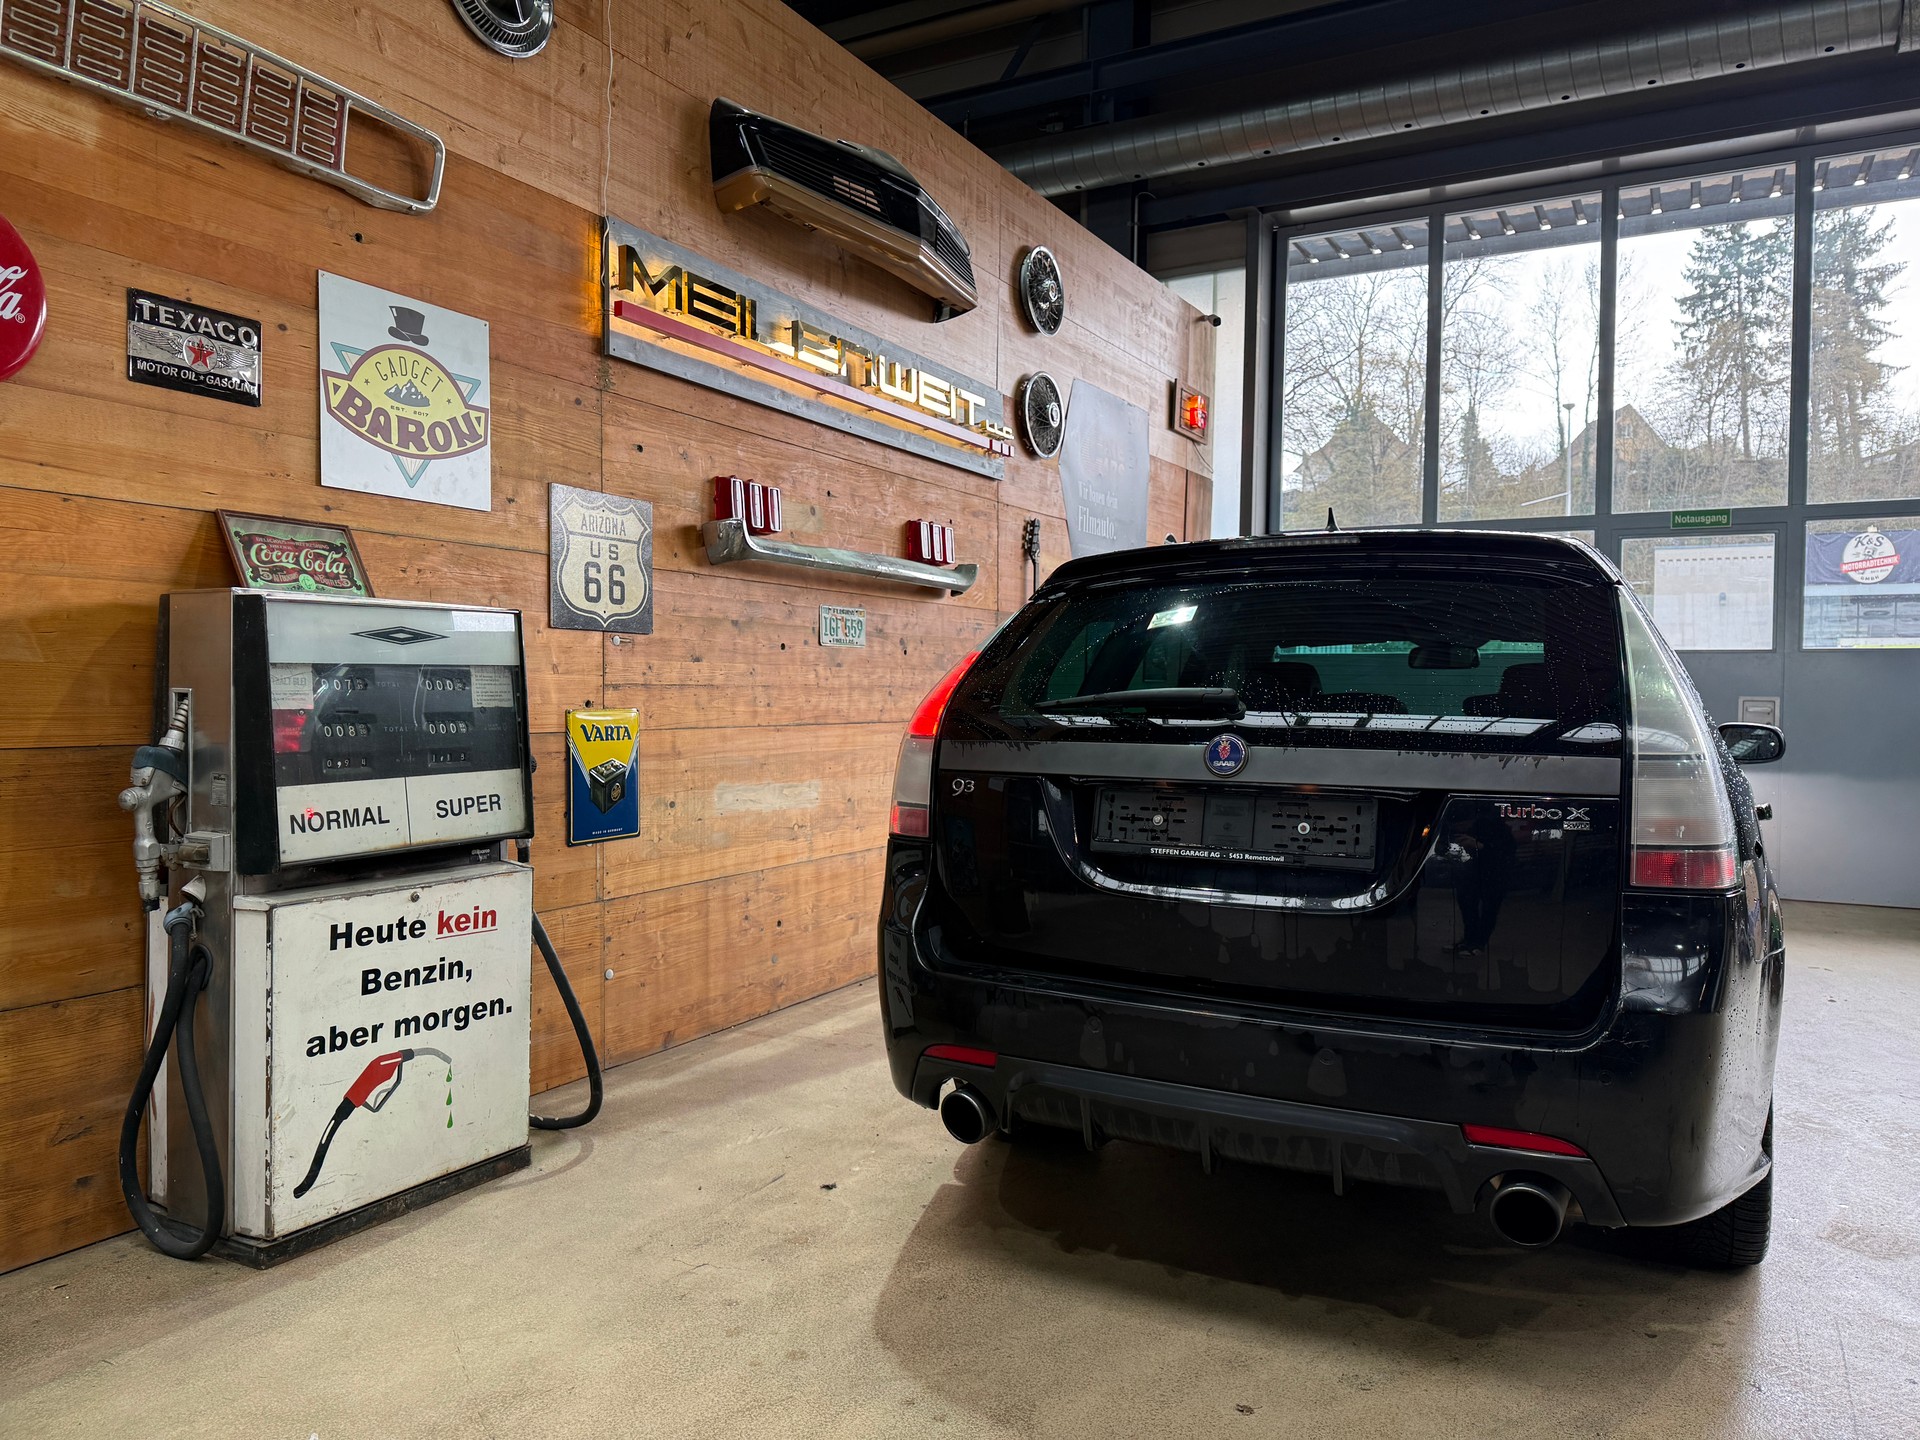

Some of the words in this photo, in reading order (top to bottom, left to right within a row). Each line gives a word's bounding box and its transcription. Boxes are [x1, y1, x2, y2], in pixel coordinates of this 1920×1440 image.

[136, 298, 258, 350] TEXACO
[614, 244, 986, 426] MEILENWEIT
[187, 338, 215, 352] TEXACO
[137, 360, 178, 377] MOTOR
[181, 369, 198, 382] OIL
[375, 356, 443, 393] GADGET
[333, 383, 482, 452] BARON
[390, 405, 407, 413] EST.
[413, 410, 429, 418] 2017
[581, 513, 627, 537] ARIZONA
[1078, 505, 1117, 540] Filmauto.
[1674, 514, 1728, 525] Notausgang
[1854, 534, 1885, 548] K&S
[250, 543, 347, 574] Coca-Cola
[1841, 556, 1899, 572] MOTORRADTECHNIK
[584, 561, 626, 606] 66
[580, 723, 632, 742] VARTA
[289, 806, 391, 835] NORMAL
[436, 793, 502, 818] SUPER
[1494, 803, 1563, 819] Turbo
[1566, 806, 1591, 821] X
[1150, 847, 1180, 856] STEFFEN
[1180, 849, 1209, 858] GARAGE
[1210, 850, 1221, 859] AG
[1228, 852, 1243, 860] 5453
[1244, 853, 1285, 862] Remetschwil
[329, 915, 427, 951] Heute
[436, 905, 498, 936] kein
[361, 956, 473, 996] Benzin,
[305, 1022, 384, 1058] aber
[394, 997, 513, 1039] morgen.
